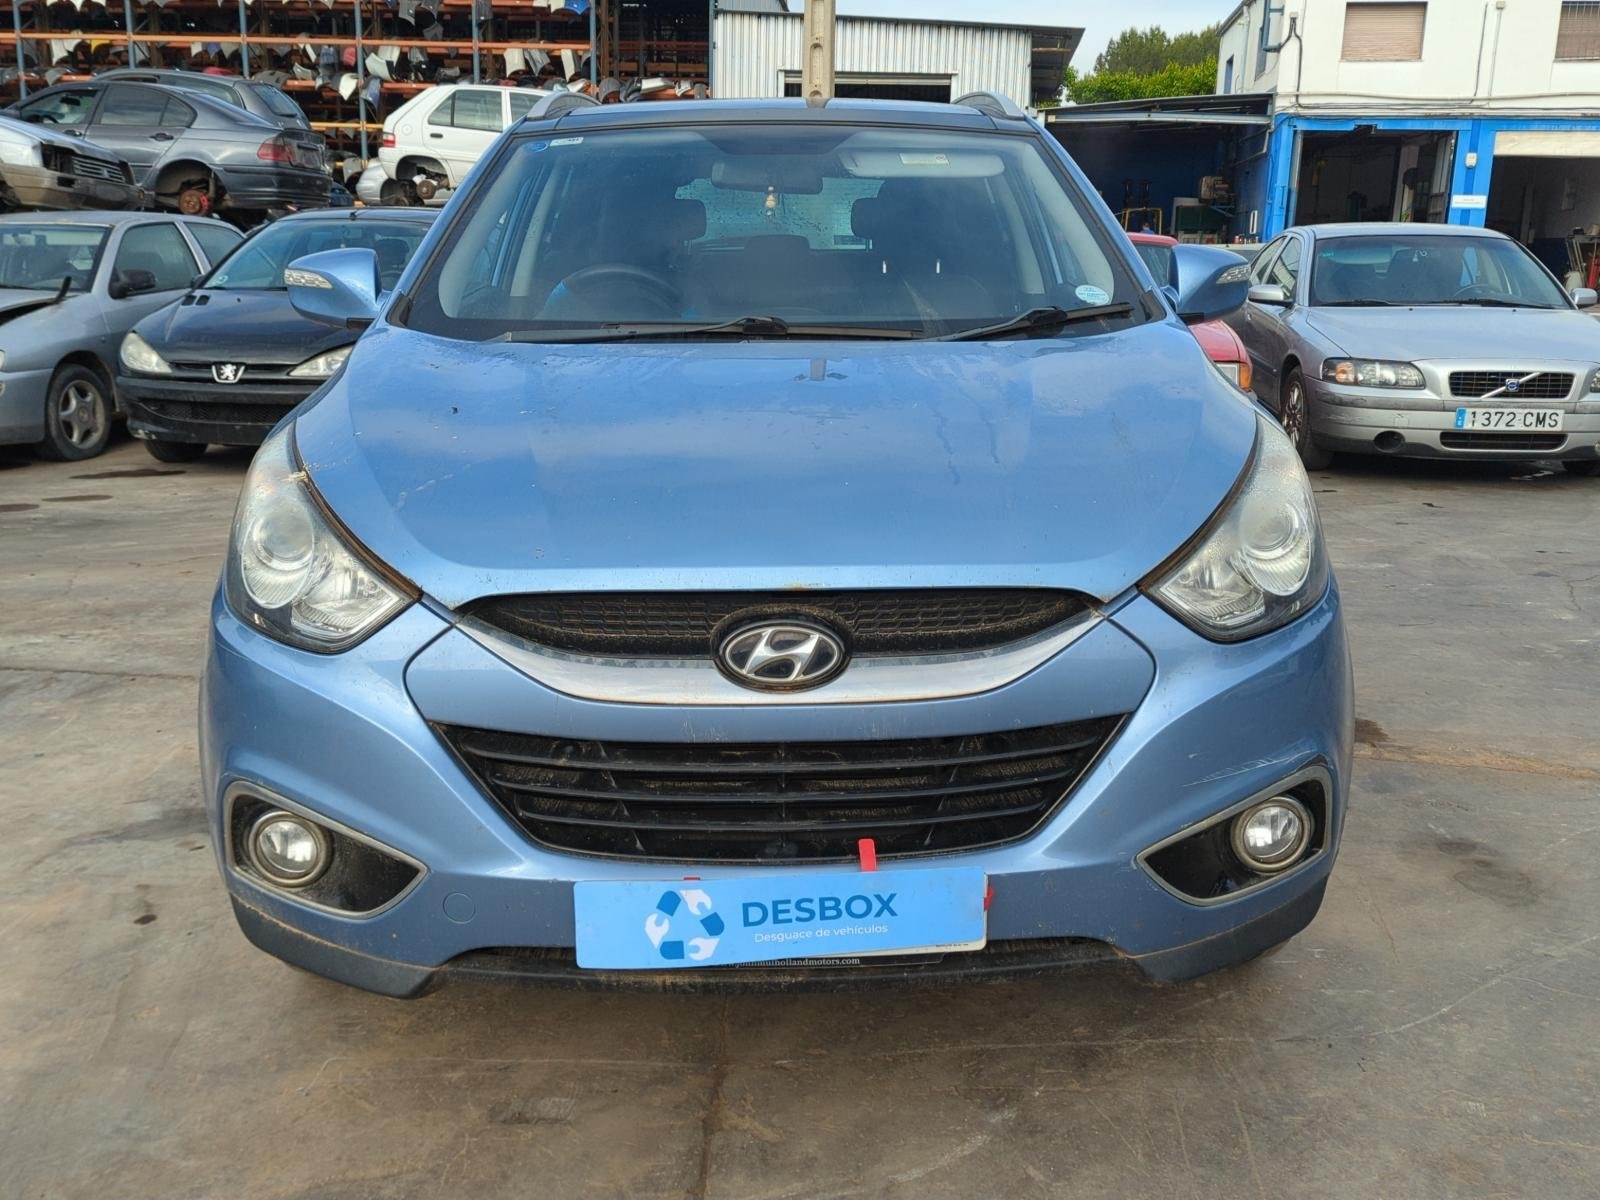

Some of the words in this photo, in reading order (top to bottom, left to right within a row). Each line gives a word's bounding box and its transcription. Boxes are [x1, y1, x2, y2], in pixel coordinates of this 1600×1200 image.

[1471, 410, 1516, 428] 1372
[1522, 411, 1560, 428] CMS
[742, 892, 898, 928] DESBOX
[754, 930, 813, 943] Desguace
[815, 928, 831, 937] de
[834, 924, 889, 936] vehículos
